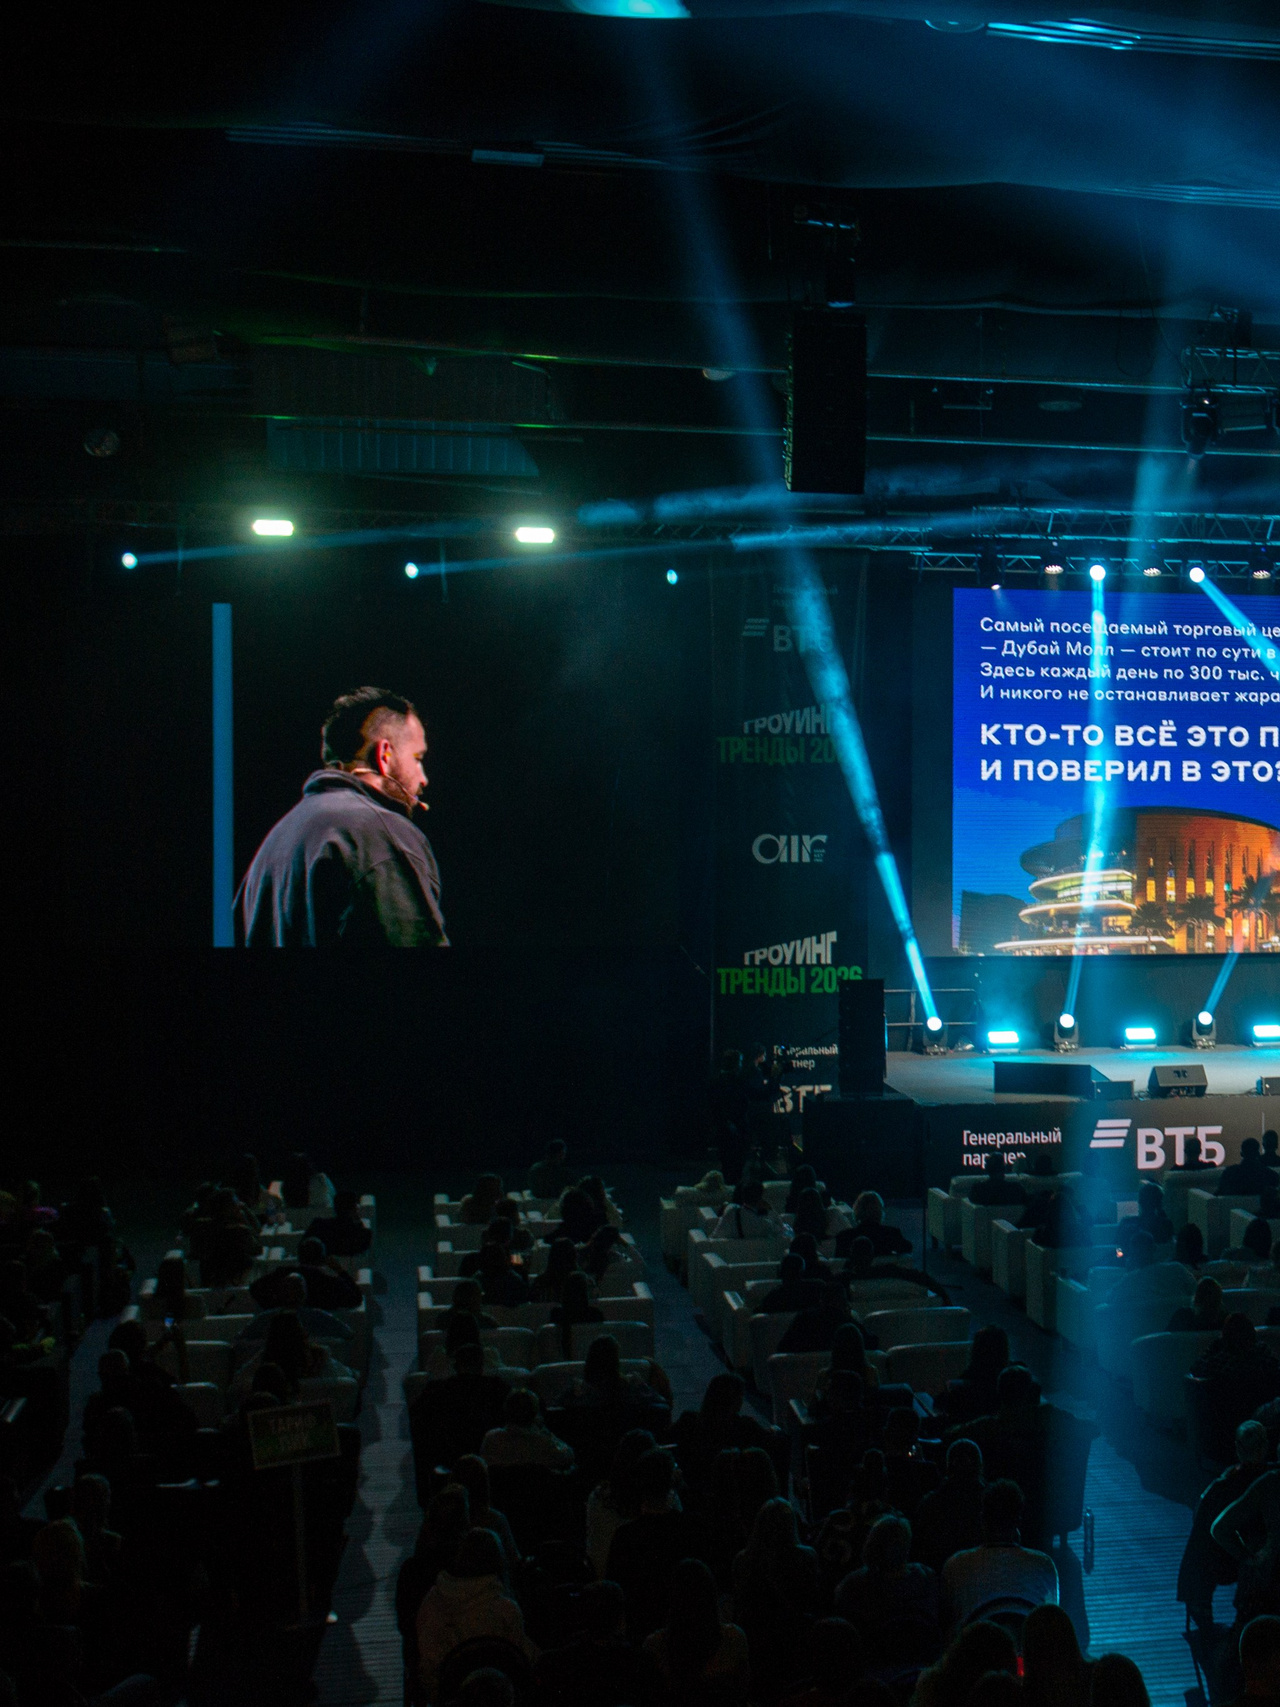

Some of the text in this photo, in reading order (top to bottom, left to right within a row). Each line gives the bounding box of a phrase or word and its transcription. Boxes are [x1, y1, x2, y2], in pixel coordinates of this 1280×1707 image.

[979, 617, 1044, 632] Самый
[1173, 622, 1256, 639] торговый
[1001, 639, 1060, 658] Дубай
[1066, 641, 1114, 656] Молл
[1141, 645, 1191, 657] стоит
[1196, 647, 1216, 658] по
[1222, 647, 1261, 662] сути
[1266, 649, 1276, 659] в
[980, 662, 1035, 679] Здесь
[1040, 664, 1111, 680] каждый
[1116, 667, 1158, 681] день
[1163, 668, 1184, 679] по
[1189, 666, 1222, 680] 300
[1228, 669, 1265, 681] тыс.
[980, 685, 993, 700] И
[1000, 689, 1062, 700] никого
[1068, 690, 1089, 700] не
[1094, 689, 1230, 702] останавливает
[1235, 691, 1280, 706] жара
[980, 723, 1105, 747] КТО-ТО
[1115, 719, 1178, 747] ВСЁ
[1187, 725, 1250, 747] ЭТО
[980, 759, 1002, 781] И
[1013, 759, 1171, 782] ПОВЕРИЛ
[1182, 760, 1202, 782] В
[744, 931, 837, 966] ГРОУИНГ
[717, 967, 806, 997] ТРЕНДЫ
[963, 1127, 1062, 1149] Генеральный
[1137, 1126, 1226, 1169] ВТБ
